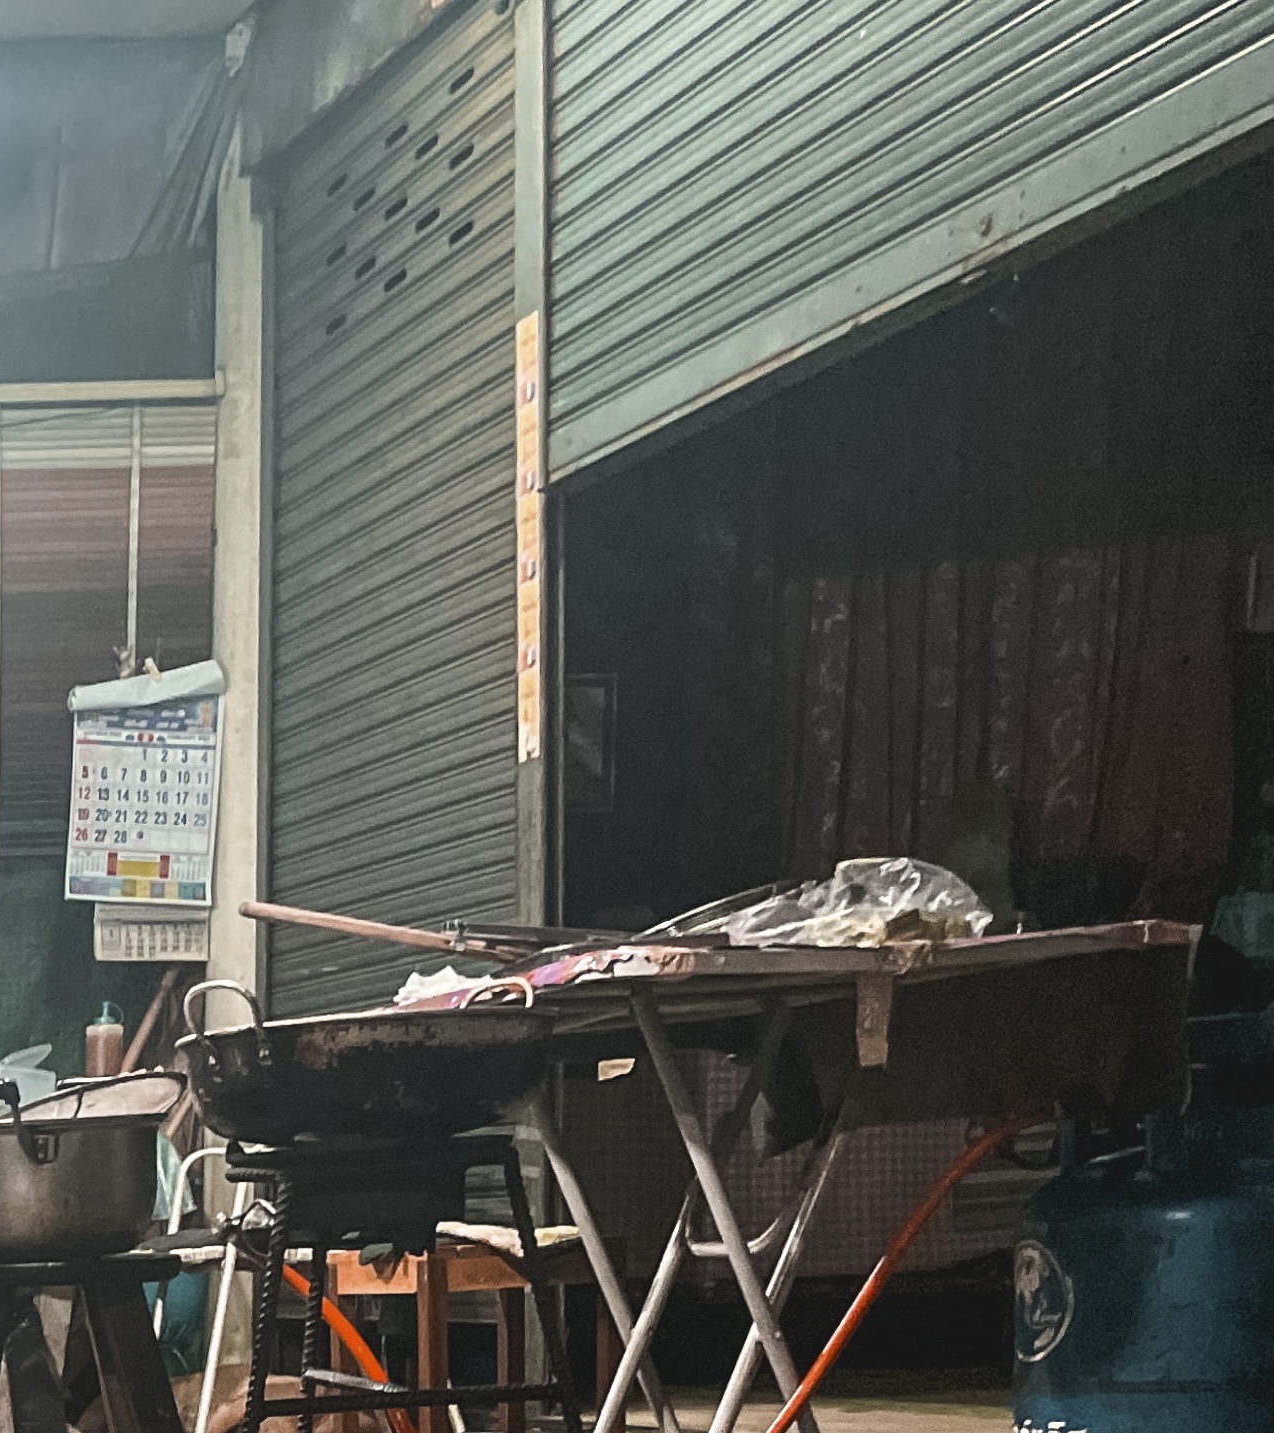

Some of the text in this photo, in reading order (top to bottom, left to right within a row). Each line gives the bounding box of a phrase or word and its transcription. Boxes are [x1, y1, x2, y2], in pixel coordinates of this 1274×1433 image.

[142, 749, 207, 763] 1 2 3 4
[82, 766, 208, 784] 5 6 7 8 9 10 11
[79, 787, 90, 800] 12
[98, 788, 109, 800] 13
[117, 790, 129, 801] 14
[137, 790, 149, 803] 15
[156, 791, 168, 804] 16
[176, 792, 188, 804] 17
[96, 809, 108, 822] 20
[115, 810, 127, 822] 21
[135, 811, 147, 823] 22
[154, 812, 167, 825] 23
[174, 812, 187, 825] 24
[193, 813, 206, 826] 25
[76, 828, 127, 843] 26 27 28
